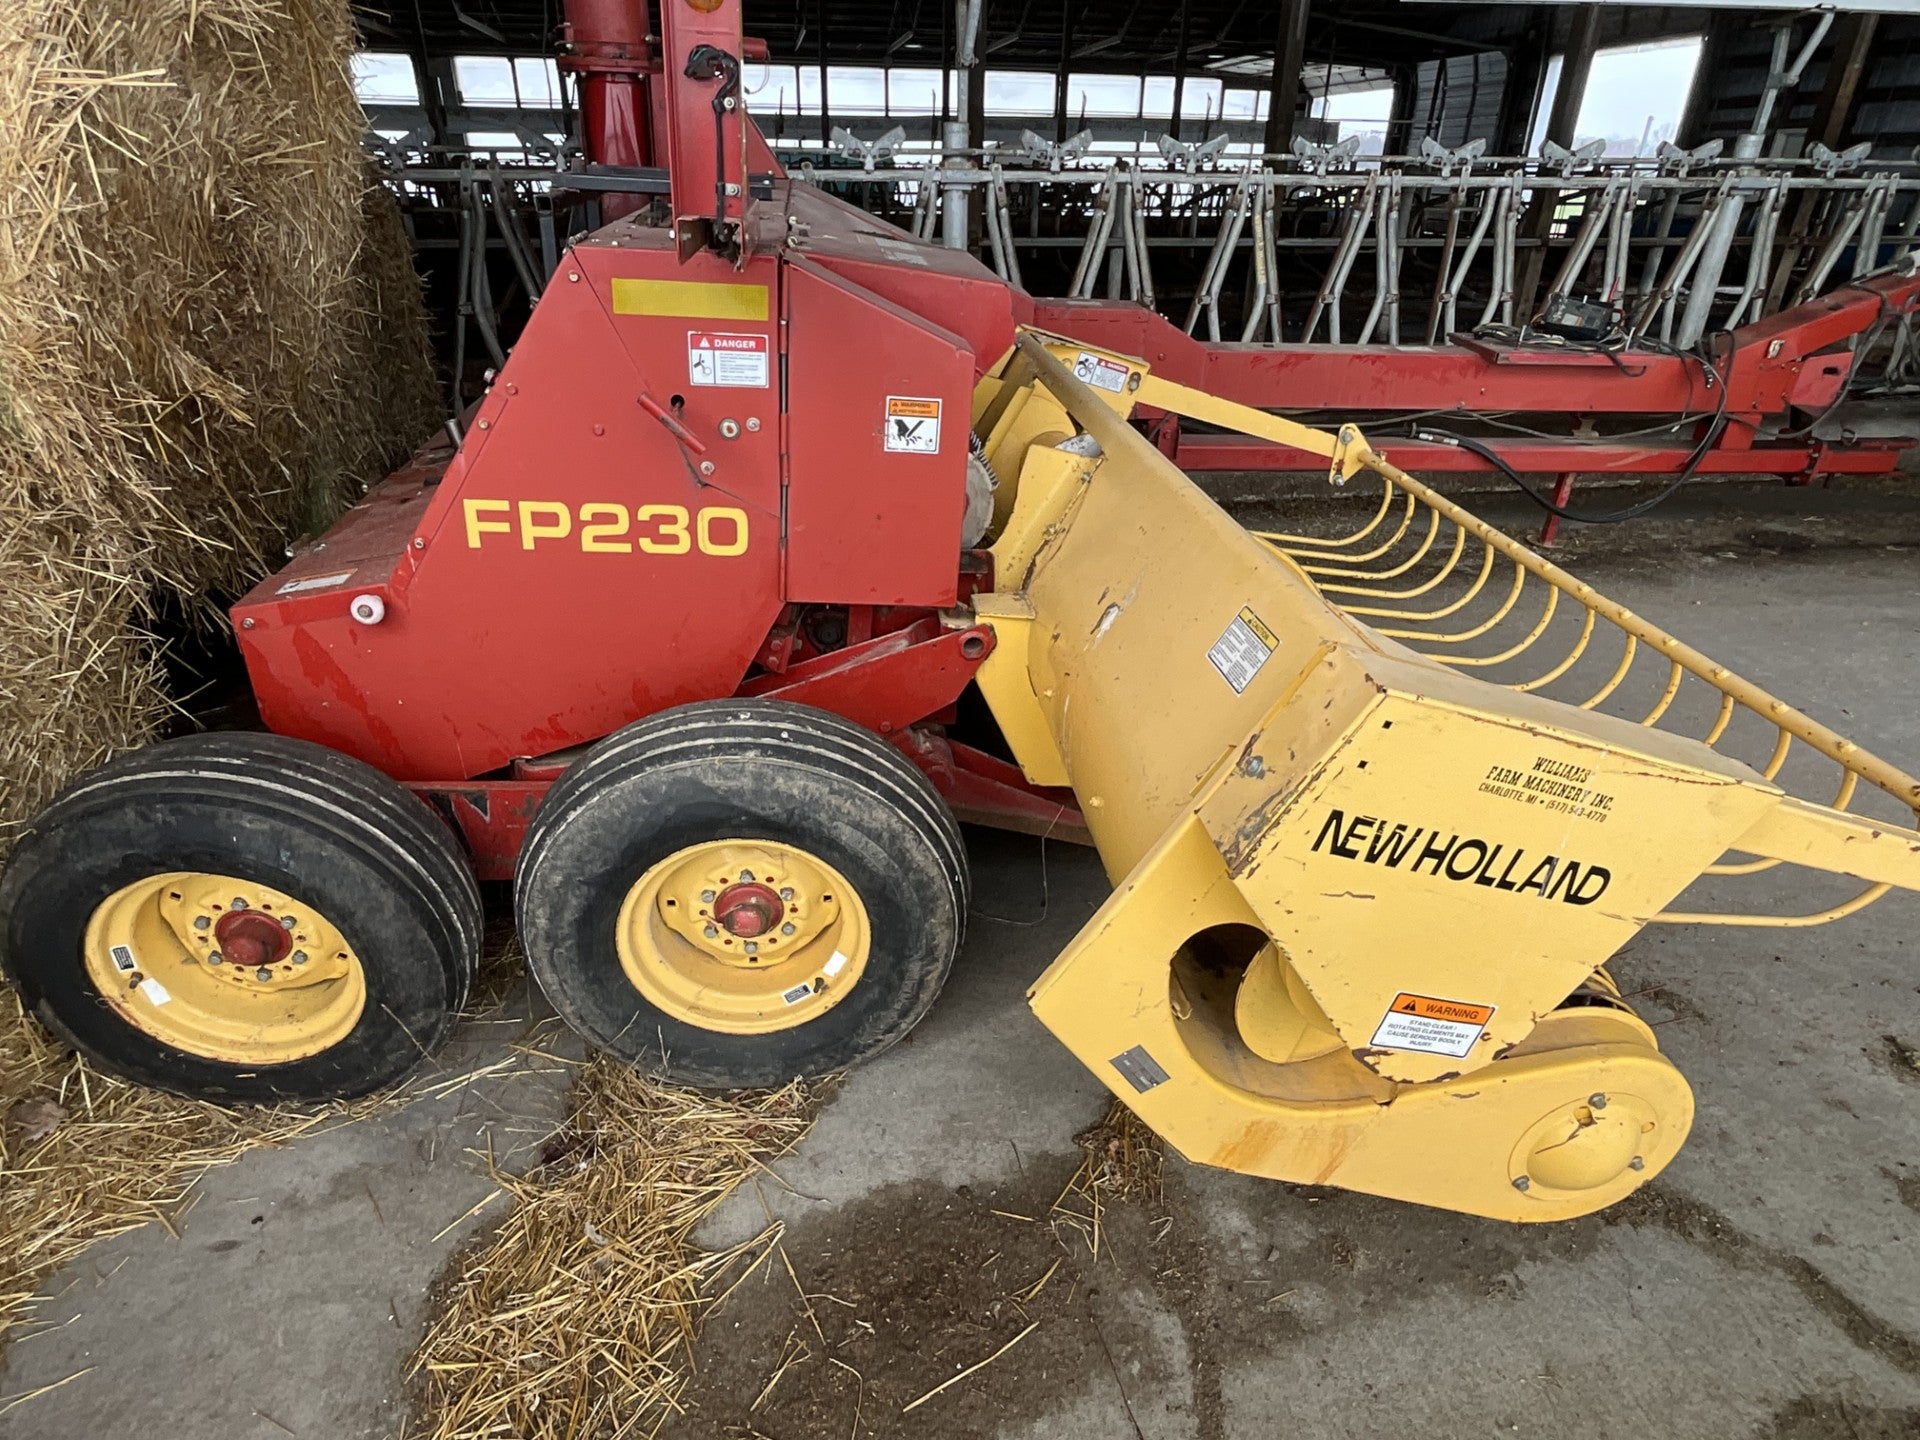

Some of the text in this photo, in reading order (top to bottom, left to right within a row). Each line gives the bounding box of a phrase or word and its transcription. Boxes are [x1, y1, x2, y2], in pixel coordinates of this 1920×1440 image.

[714, 338, 756, 349] DANGER
[463, 498, 749, 557] FP230
[1486, 765, 1614, 811] FARM MACHINERY INC.
[1525, 793, 1539, 804] MI
[1544, 799, 1568, 815] (517)
[1310, 808, 1612, 906] NEW HOLLAND
[1425, 1003, 1479, 1020] WARNING
[1388, 1023, 1421, 1033] ROTATING
[1421, 1028, 1455, 1037] ELEMENTS
[1409, 1019, 1432, 1028] STAND
[1387, 1030, 1462, 1045] CAUSE SERIOUS BODILY
